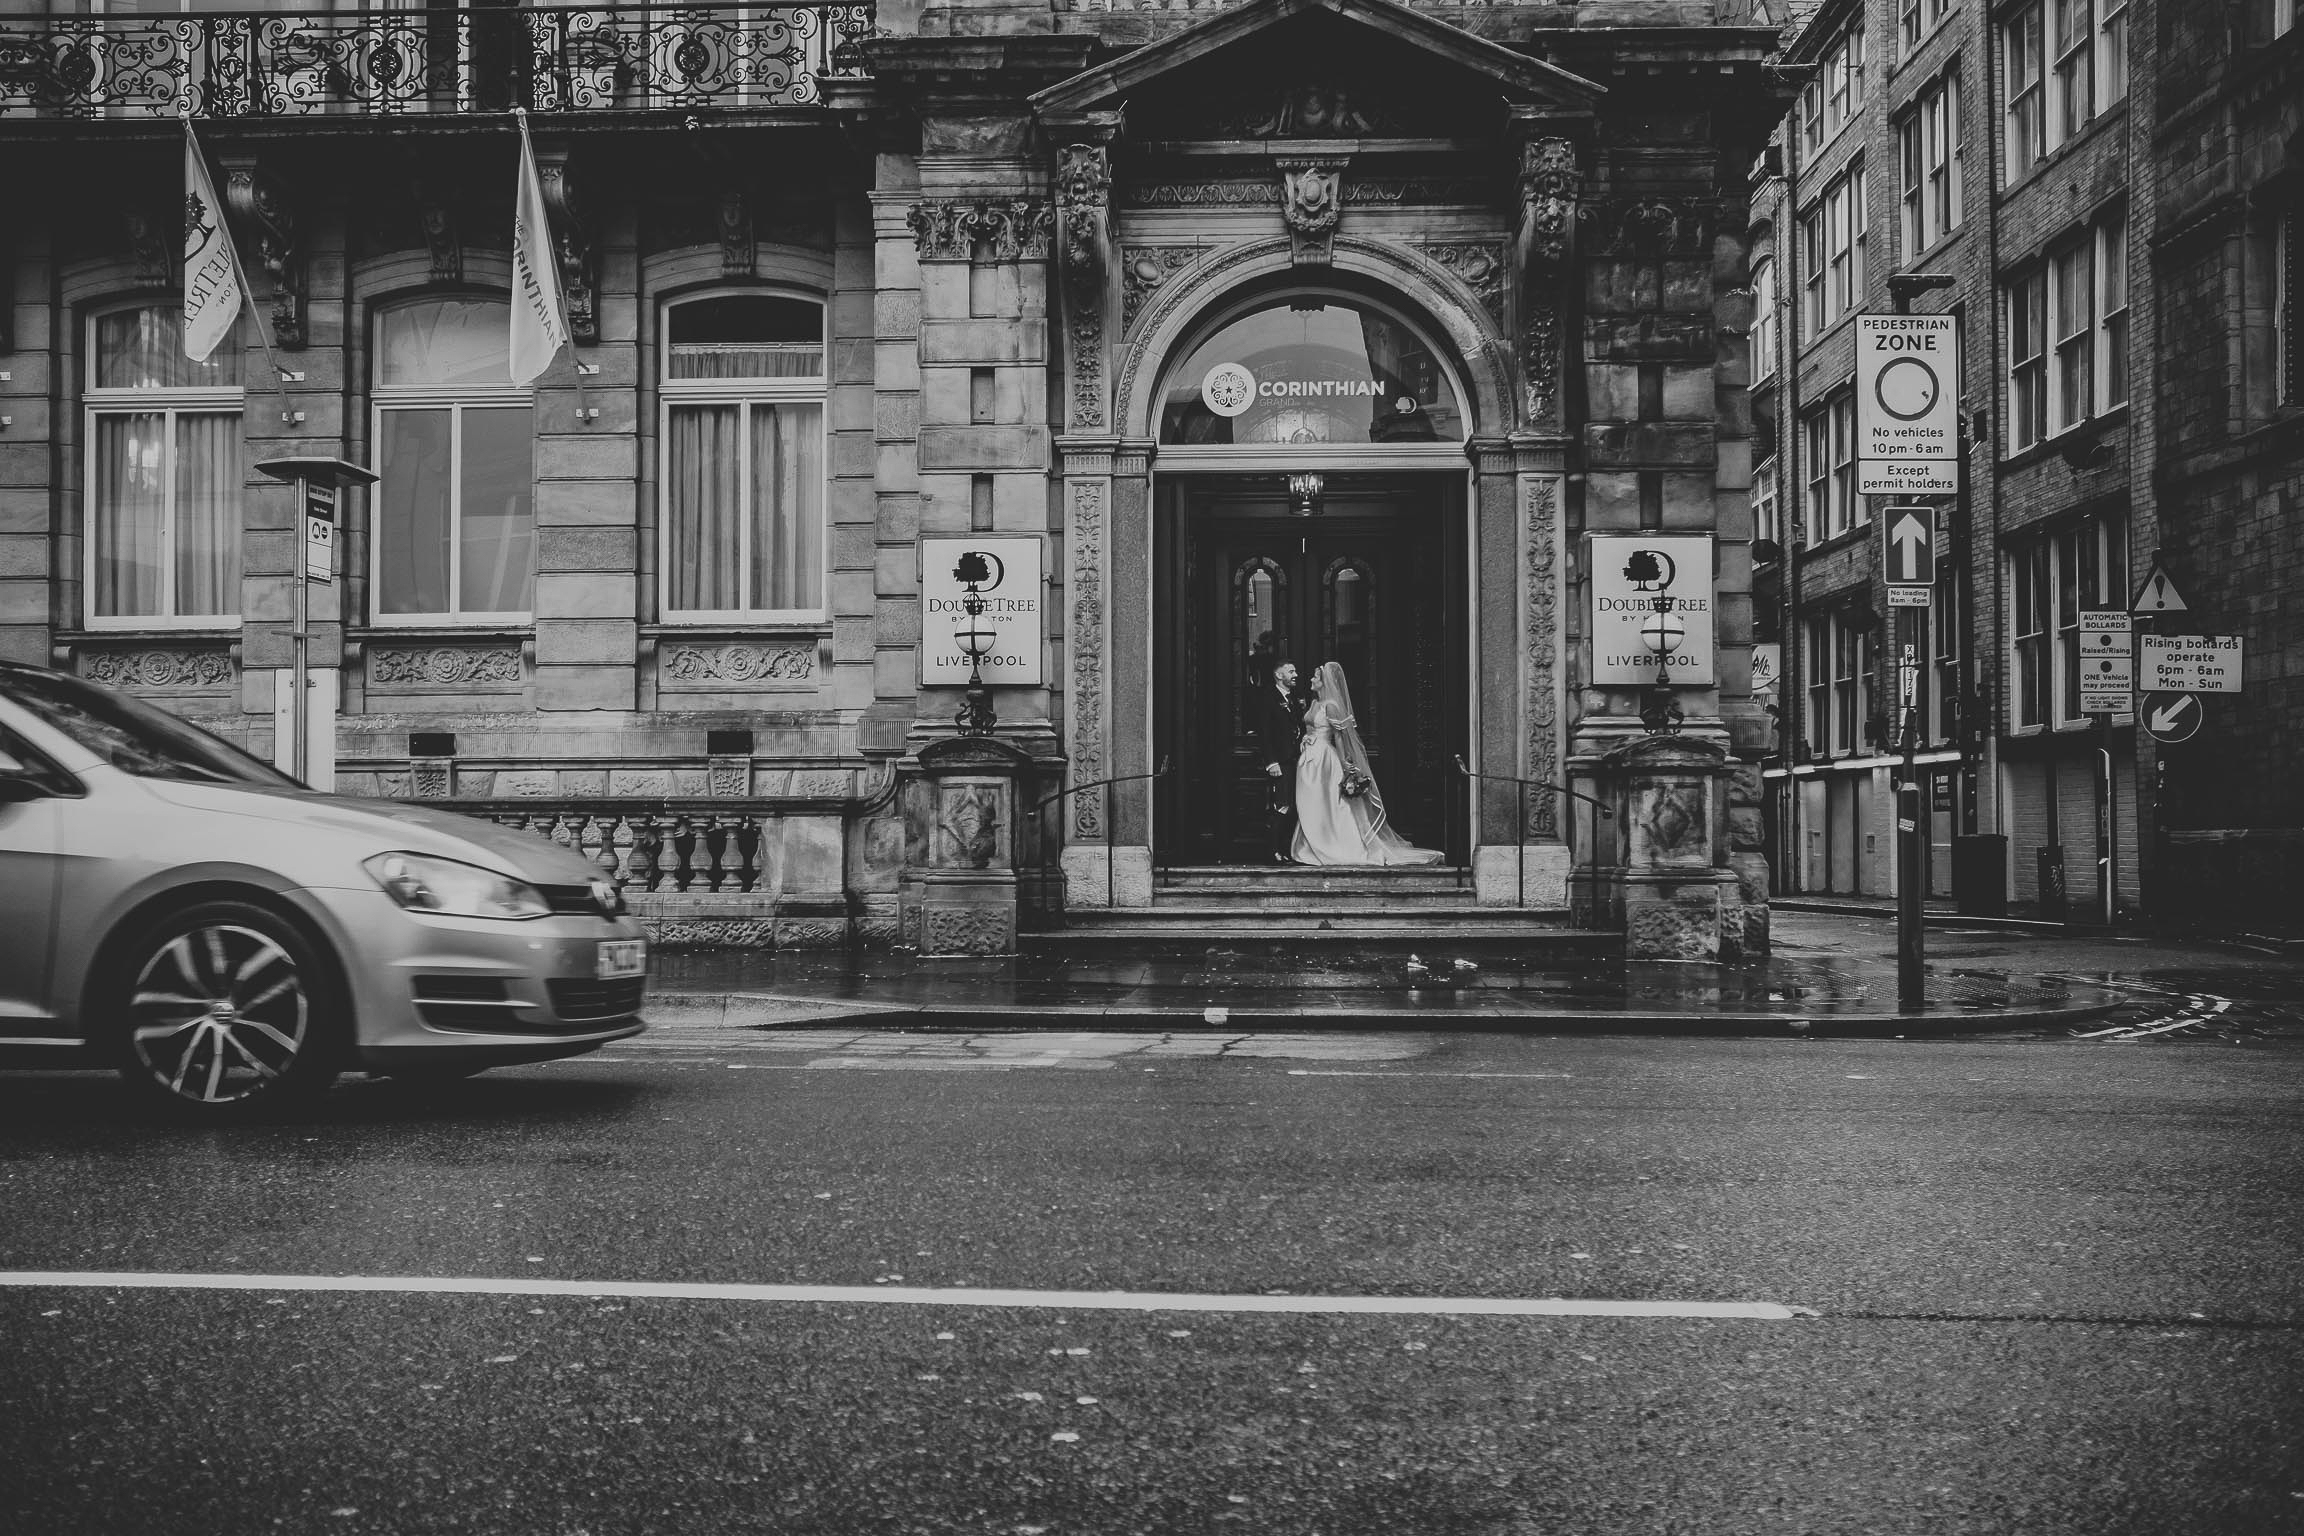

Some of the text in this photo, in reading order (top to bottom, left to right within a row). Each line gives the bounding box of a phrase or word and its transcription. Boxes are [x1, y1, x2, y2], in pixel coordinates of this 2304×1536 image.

[1863, 319, 1949, 330] PEDESTRIAN
[1875, 334, 1936, 351] ZONE
[1258, 381, 1385, 397] CORINTHIAN
[1260, 398, 1295, 407] GRAND
[1872, 427, 1944, 437] No vehicles
[1887, 465, 1930, 476] Except
[1863, 478, 1954, 490] permit holders
[1902, 589, 1928, 597] loading
[929, 598, 1036, 613] DOUETREE
[1599, 598, 1708, 612] DOUBLREE
[2145, 638, 2239, 650] Rising bollards
[2081, 647, 2131, 655] Raised/Rising
[2166, 653, 2215, 663] operate
[2157, 665, 2184, 676] 6pm
[2197, 666, 2224, 675] 6am
[2100, 682, 2130, 690] proceed
[2159, 678, 2185, 687] Mon
[2198, 679, 2223, 688] Sun
